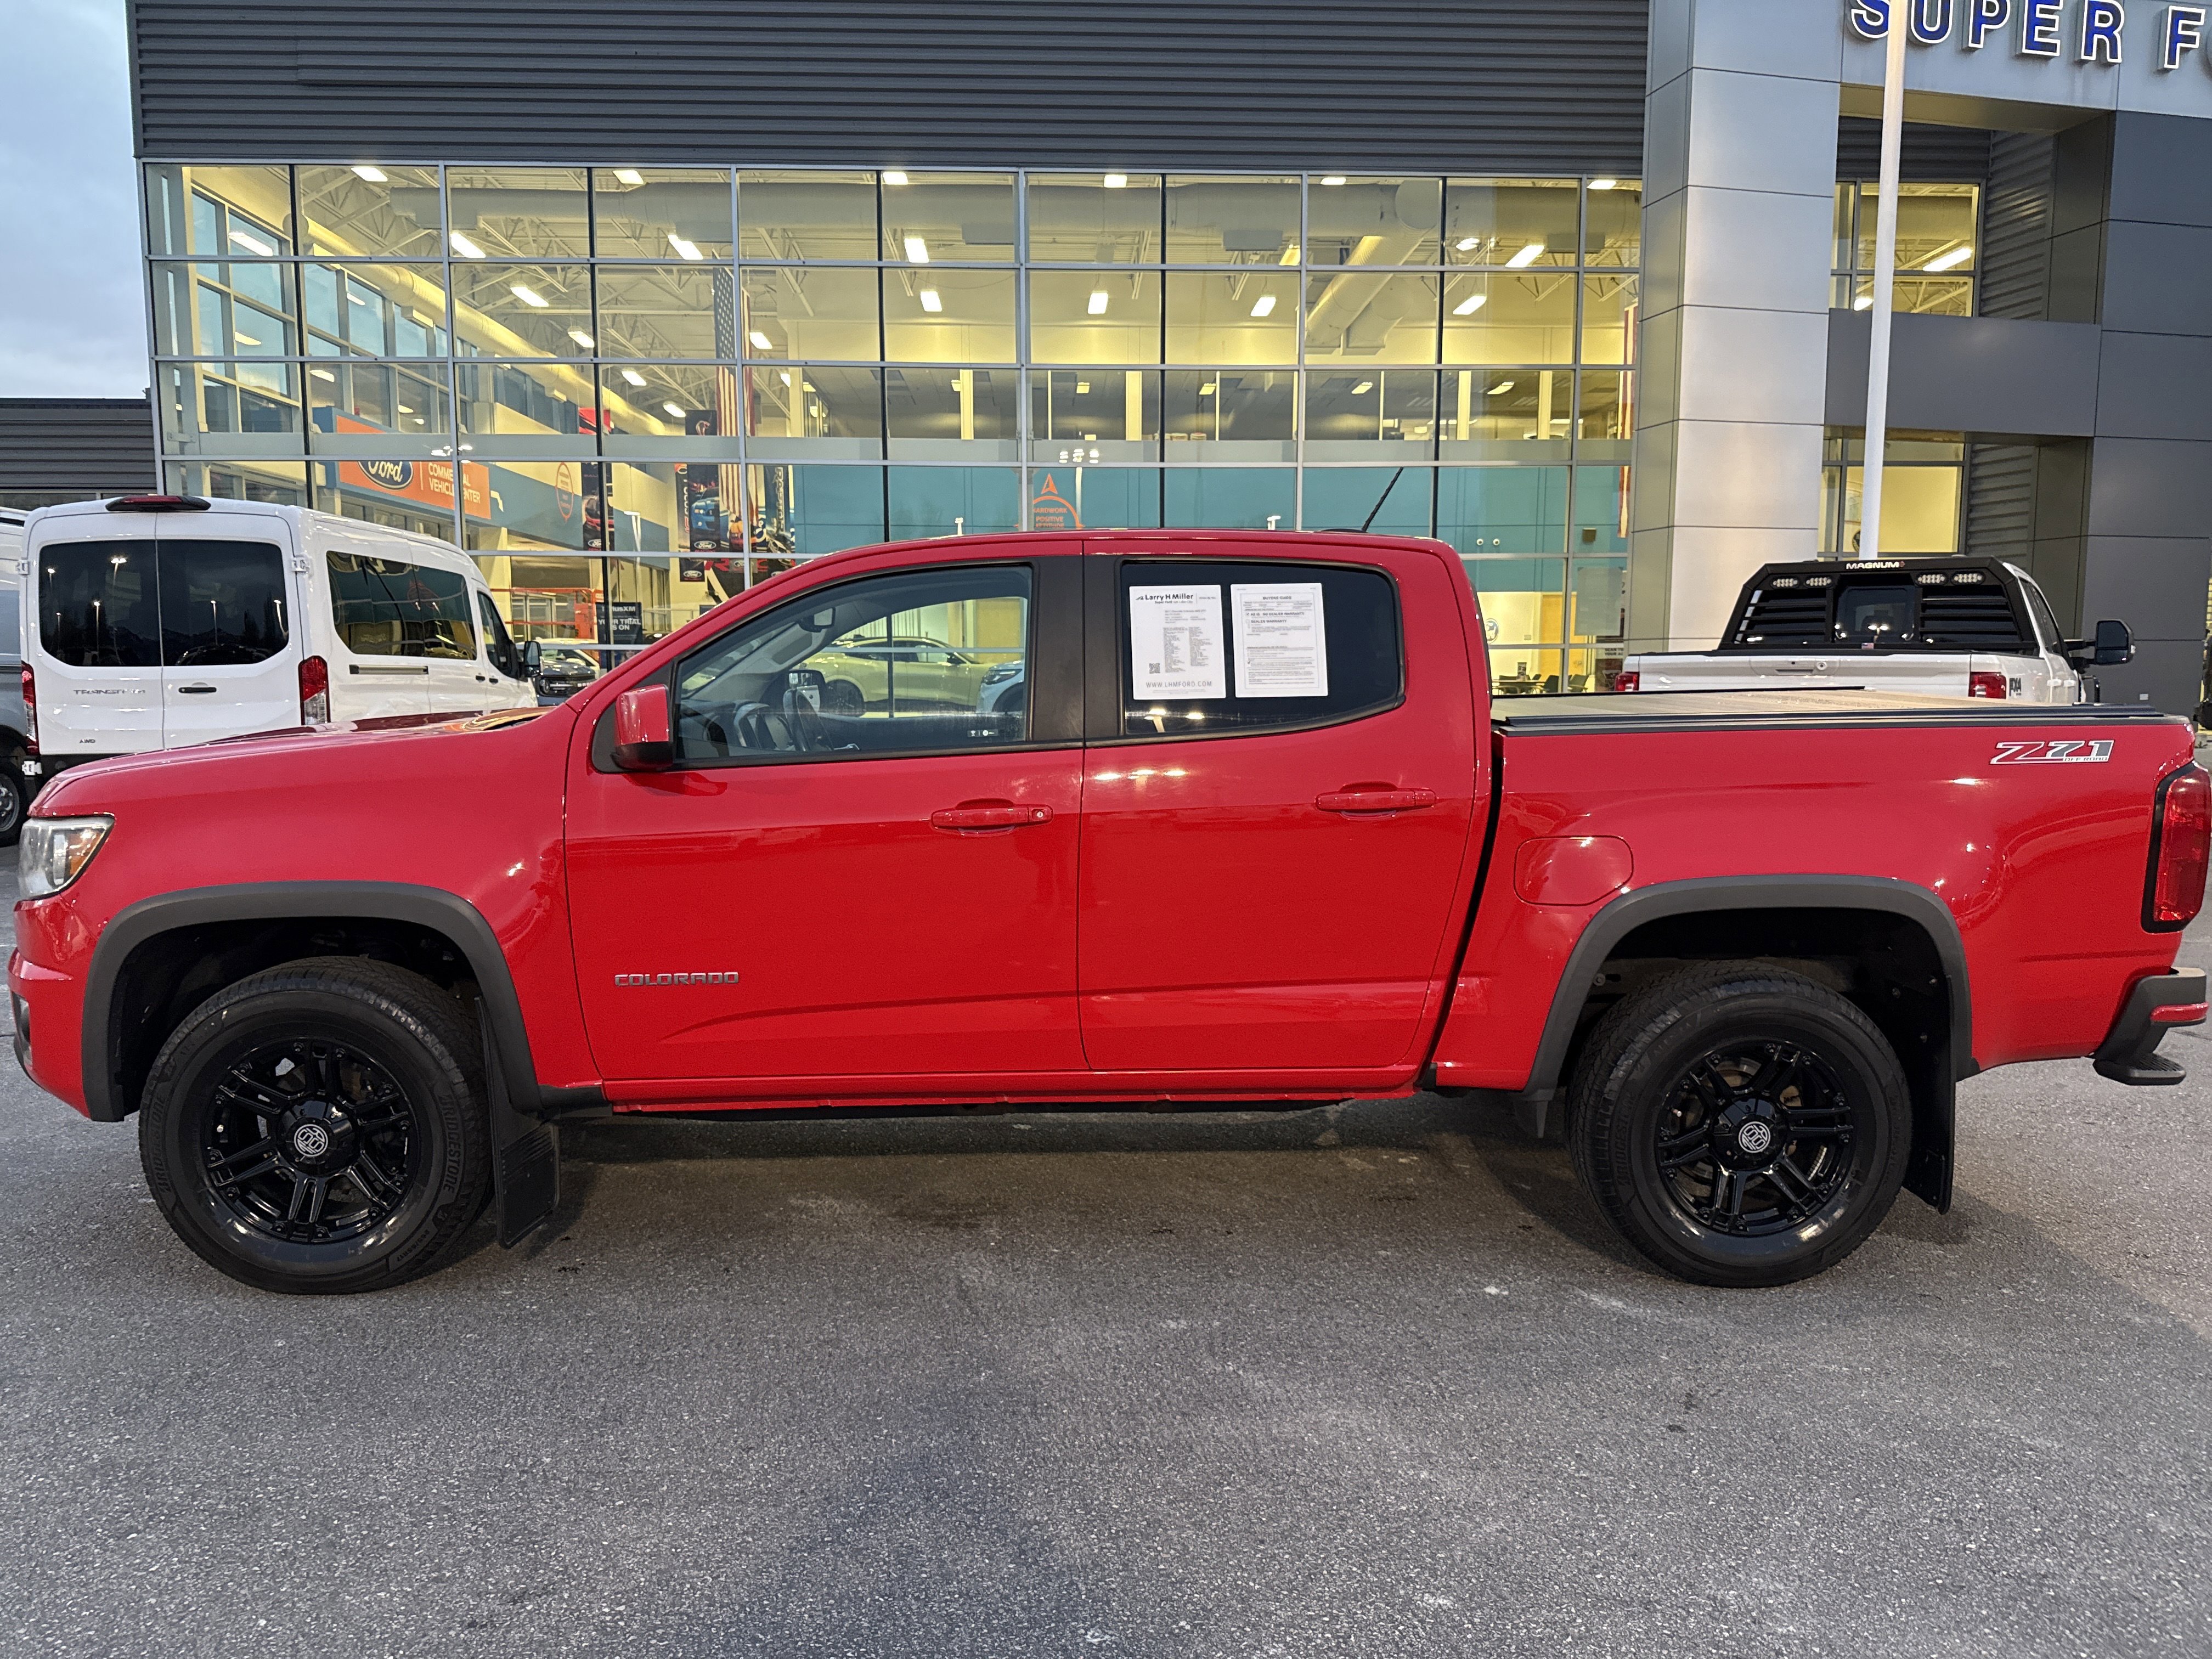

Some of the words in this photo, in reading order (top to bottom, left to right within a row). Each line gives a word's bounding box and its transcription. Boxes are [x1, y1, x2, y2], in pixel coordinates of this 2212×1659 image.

[1846, 561, 1899, 569] MAGNUM
[1989, 740, 2115, 765] Z71
[614, 972, 739, 987] COLORADO
[438, 1093, 462, 1193] BRIDGESTONE
